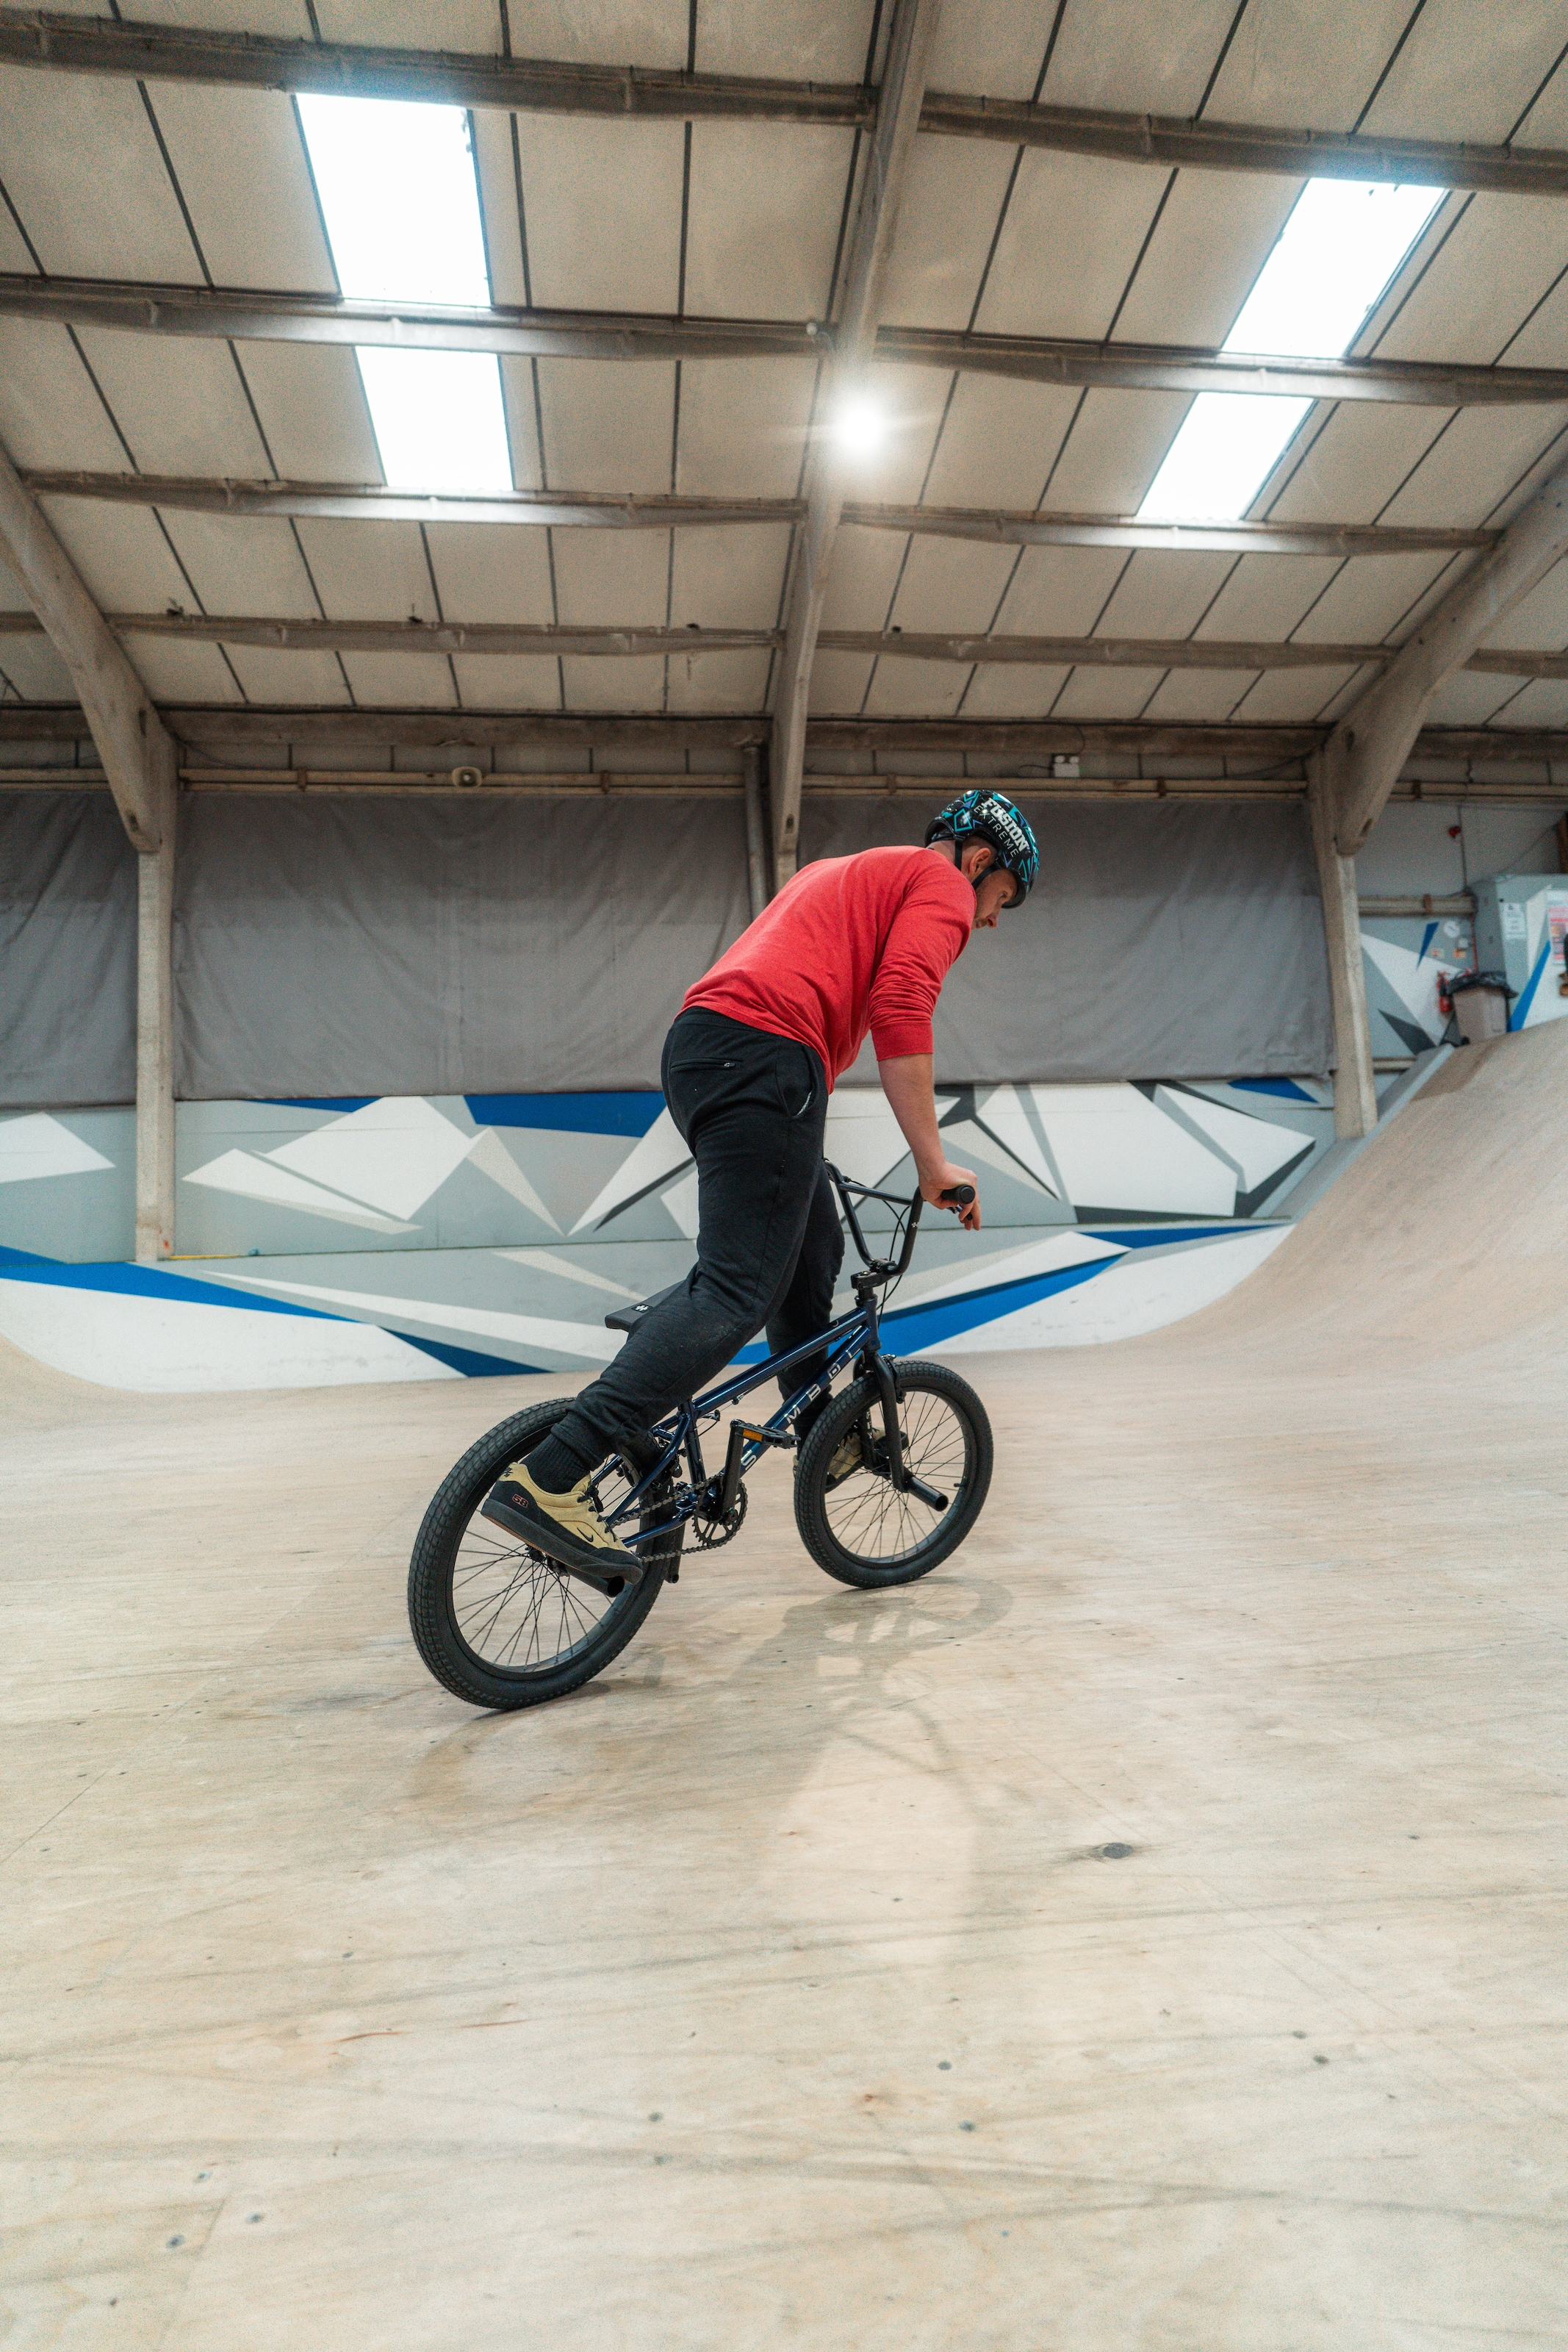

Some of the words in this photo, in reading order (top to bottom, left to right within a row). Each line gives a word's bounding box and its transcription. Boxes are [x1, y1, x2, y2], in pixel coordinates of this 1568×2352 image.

[974, 806, 1019, 857] EXTREME
[982, 797, 1029, 851] FUSION
[740, 1348, 861, 1470] SMBOL
[512, 1494, 528, 1507] 58
